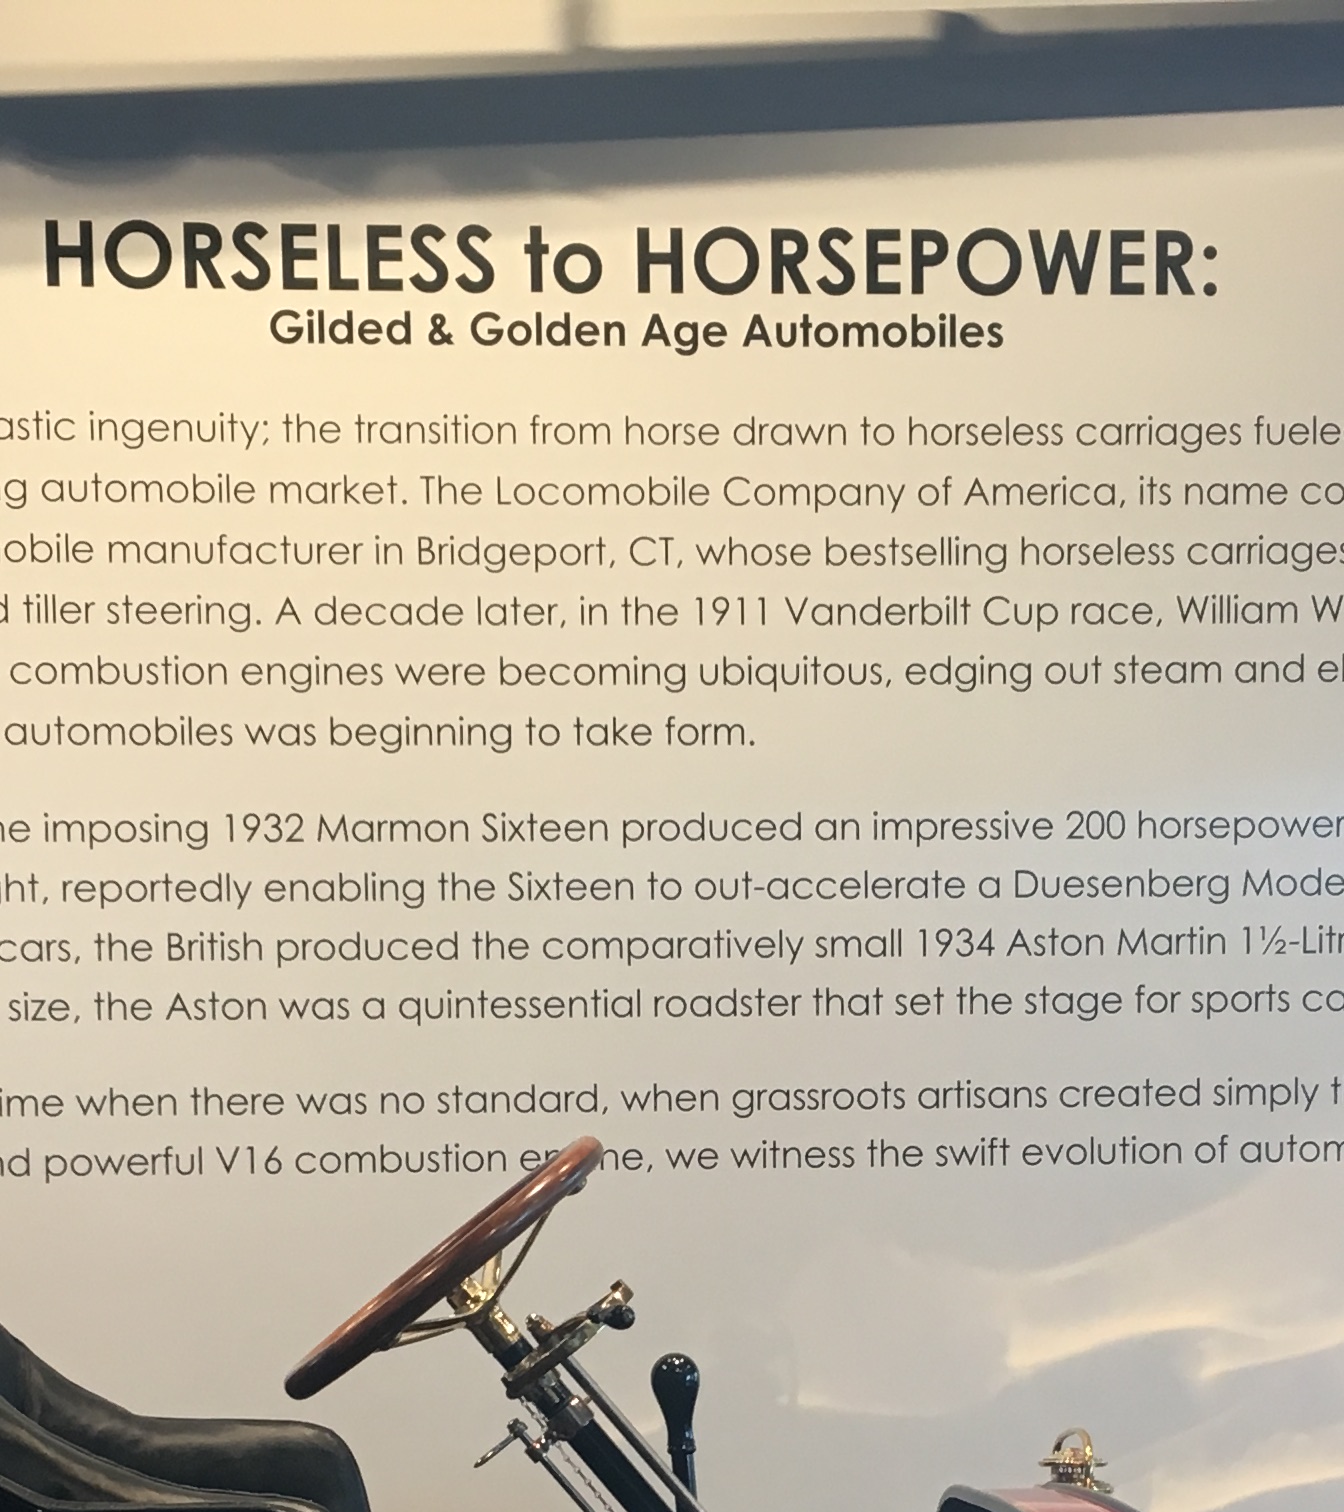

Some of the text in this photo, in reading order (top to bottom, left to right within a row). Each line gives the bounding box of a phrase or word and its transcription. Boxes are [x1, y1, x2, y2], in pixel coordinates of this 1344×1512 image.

[44, 219, 1218, 297] HORSELESS to HORSEPOWER:
[269, 308, 1004, 357] Gilded & Golden Age Automobiles
[88, 410, 270, 451] ingenuity;
[281, 412, 342, 445] the
[354, 413, 517, 446] transition
[529, 413, 611, 446] from
[624, 415, 720, 447] horse
[732, 415, 847, 447] drawn
[859, 415, 895, 447] to
[908, 415, 1064, 447] horseless
[1075, 414, 1242, 454] carriages
[9, 654, 228, 686] combustion
[240, 654, 384, 694] engines
[394, 662, 486, 687] were
[499, 654, 687, 694] becoming
[699, 654, 892, 693] ubiquitous,
[904, 654, 1032, 693] edging
[1044, 654, 1103, 686] out
[1113, 654, 1222, 685] steam
[1234, 652, 1305, 684] and
[3, 715, 234, 747] automobiles
[243, 723, 317, 747] was
[329, 715, 513, 755] beginning
[524, 716, 561, 747] to
[572, 715, 653, 747] take
[664, 715, 756, 747] form.
[43, 812, 209, 851] imposing
[225, 812, 305, 844] 1932
[316, 813, 470, 843] Marmon
[481, 811, 609, 843] Sixteen
[622, 811, 802, 849] produced
[814, 818, 861, 842] an
[872, 809, 1054, 848] impressive
[1065, 809, 1126, 841] 200
[44, 1145, 204, 1184] powerful
[215, 1145, 283, 1175] V16
[294, 1142, 507, 1175] combustion
[519, 1148, 653, 1173] enne,
[664, 1147, 720, 1171] we
[729, 1139, 856, 1169] witness
[866, 1138, 924, 1168] the
[935, 1136, 1011, 1168] swift
[1021, 1134, 1183, 1167] evolution
[1194, 1134, 1230, 1165] of
